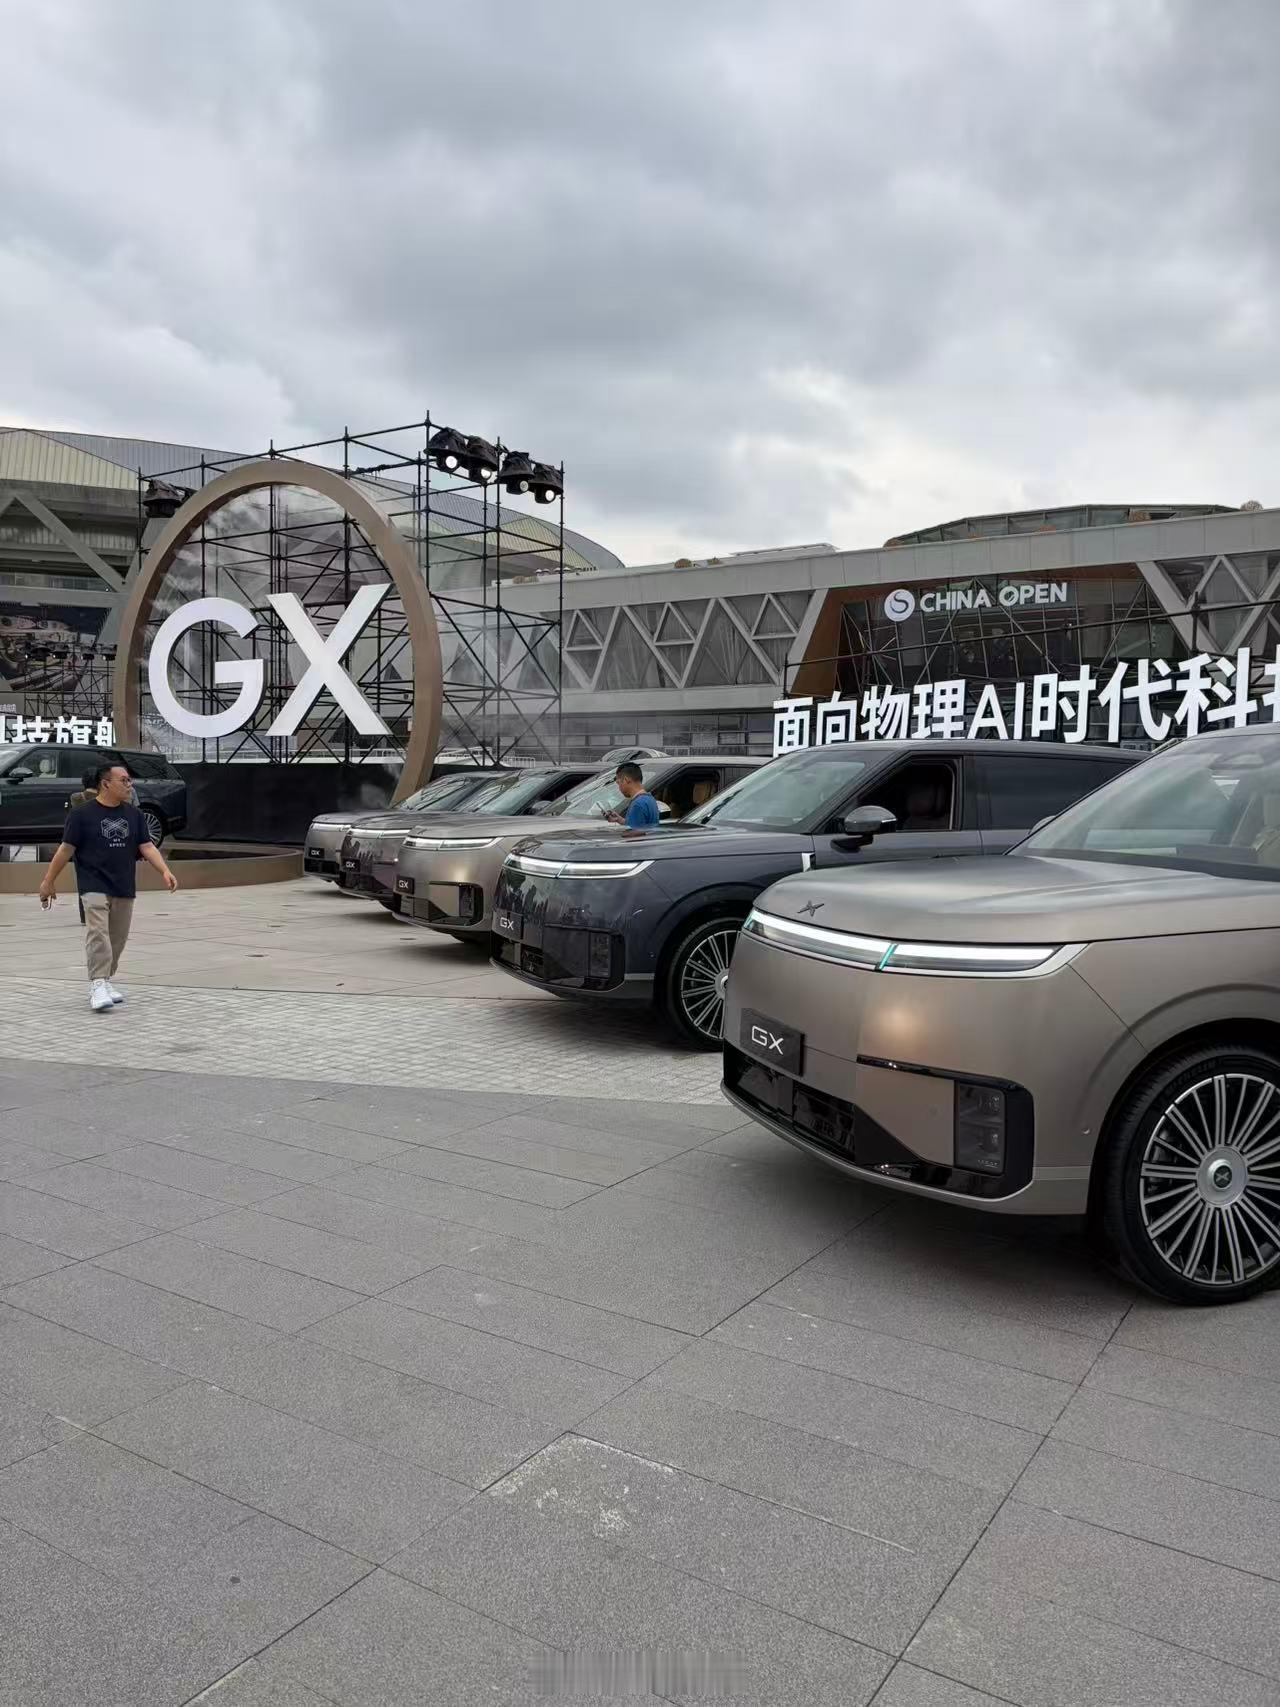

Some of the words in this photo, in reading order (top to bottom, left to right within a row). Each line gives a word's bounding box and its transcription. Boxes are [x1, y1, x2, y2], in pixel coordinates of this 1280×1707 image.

[920, 588, 992, 612] CHINA
[998, 582, 1068, 607] OPEN
[148, 583, 393, 738] GX
[398, 880, 409, 888] GX
[499, 917, 514, 930] GX
[751, 1025, 784, 1055] GX
